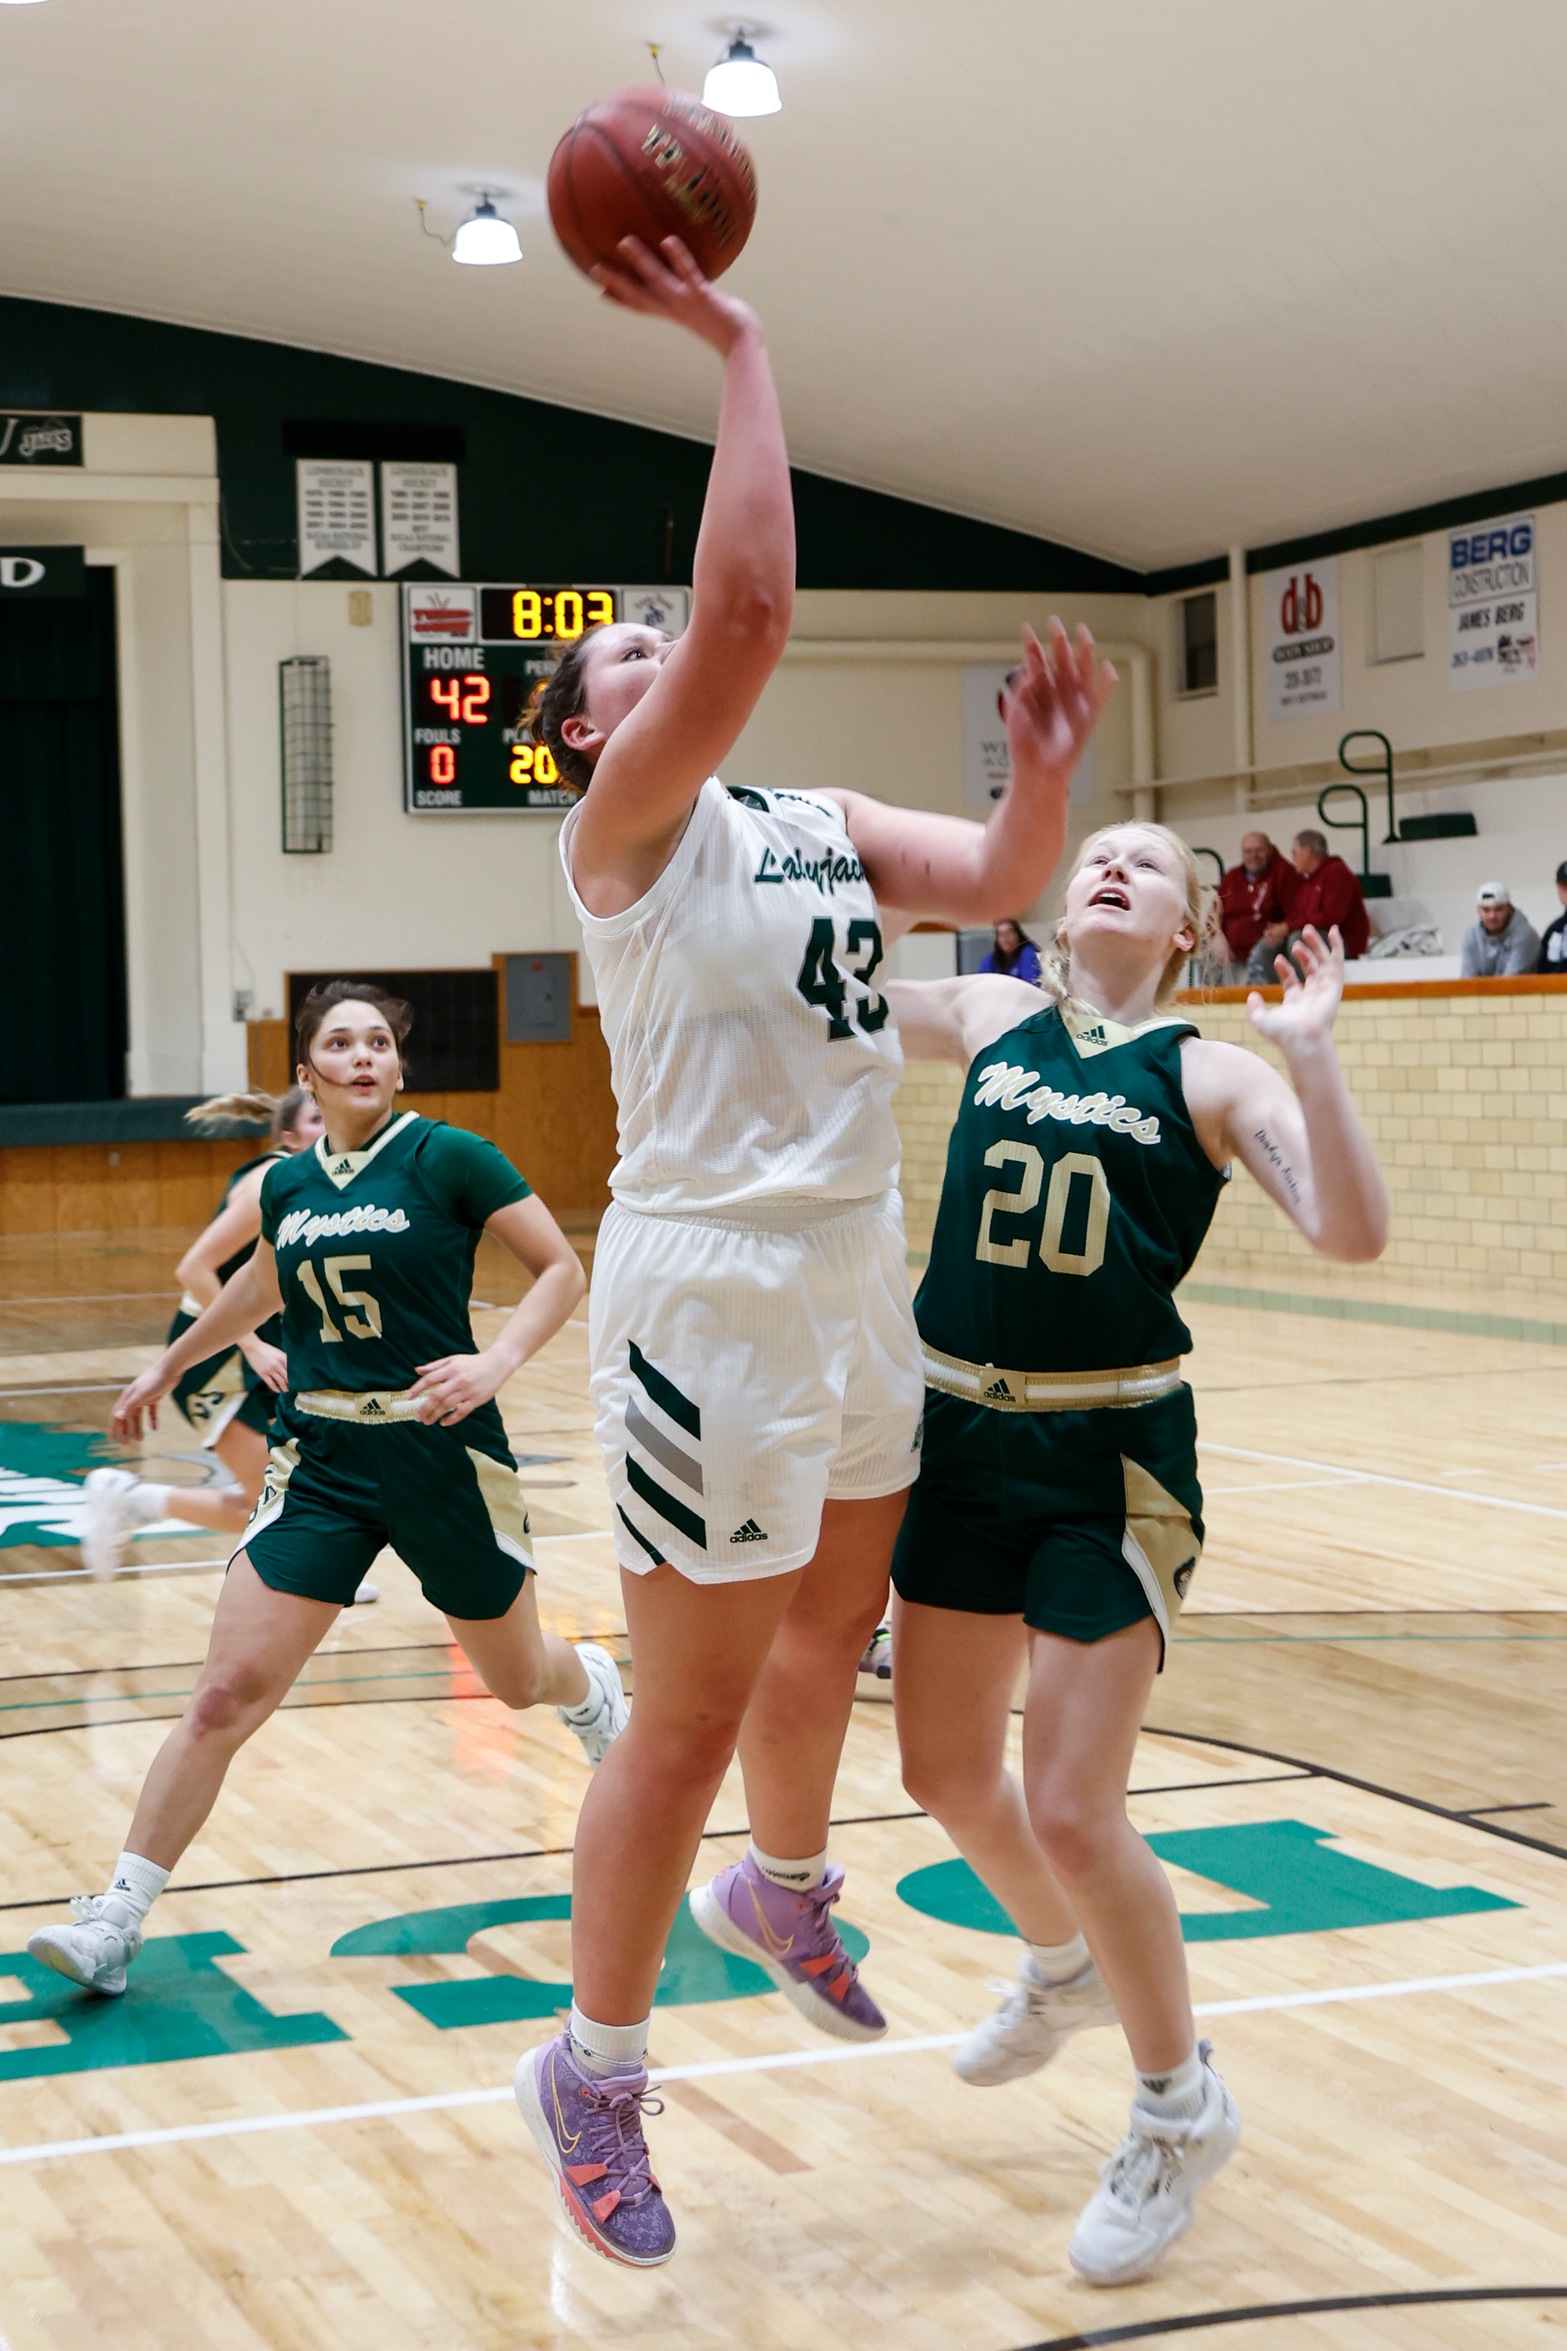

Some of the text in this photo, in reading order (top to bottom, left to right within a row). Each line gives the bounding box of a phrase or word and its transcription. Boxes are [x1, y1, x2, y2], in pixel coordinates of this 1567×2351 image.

[1452, 524, 1532, 570] BERG
[513, 590, 613, 639] 8:03
[424, 647, 485, 670] HOME
[430, 676, 491, 723] 42
[415, 728, 461, 745] FOULS
[502, 728, 533, 744] PLA
[430, 745, 455, 784] 0
[416, 790, 463, 807] SCORE
[796, 916, 890, 1042] 43
[1075, 1033, 1108, 1047] adidas
[974, 1061, 1161, 1145] Mystics
[276, 1203, 411, 1251] Mystics
[975, 1139, 1111, 1277] 20
[296, 1254, 384, 1344] 15
[359, 1407, 386, 1416] adidas
[983, 1390, 1017, 1402] adidas
[729, 1532, 768, 1543] adidas
